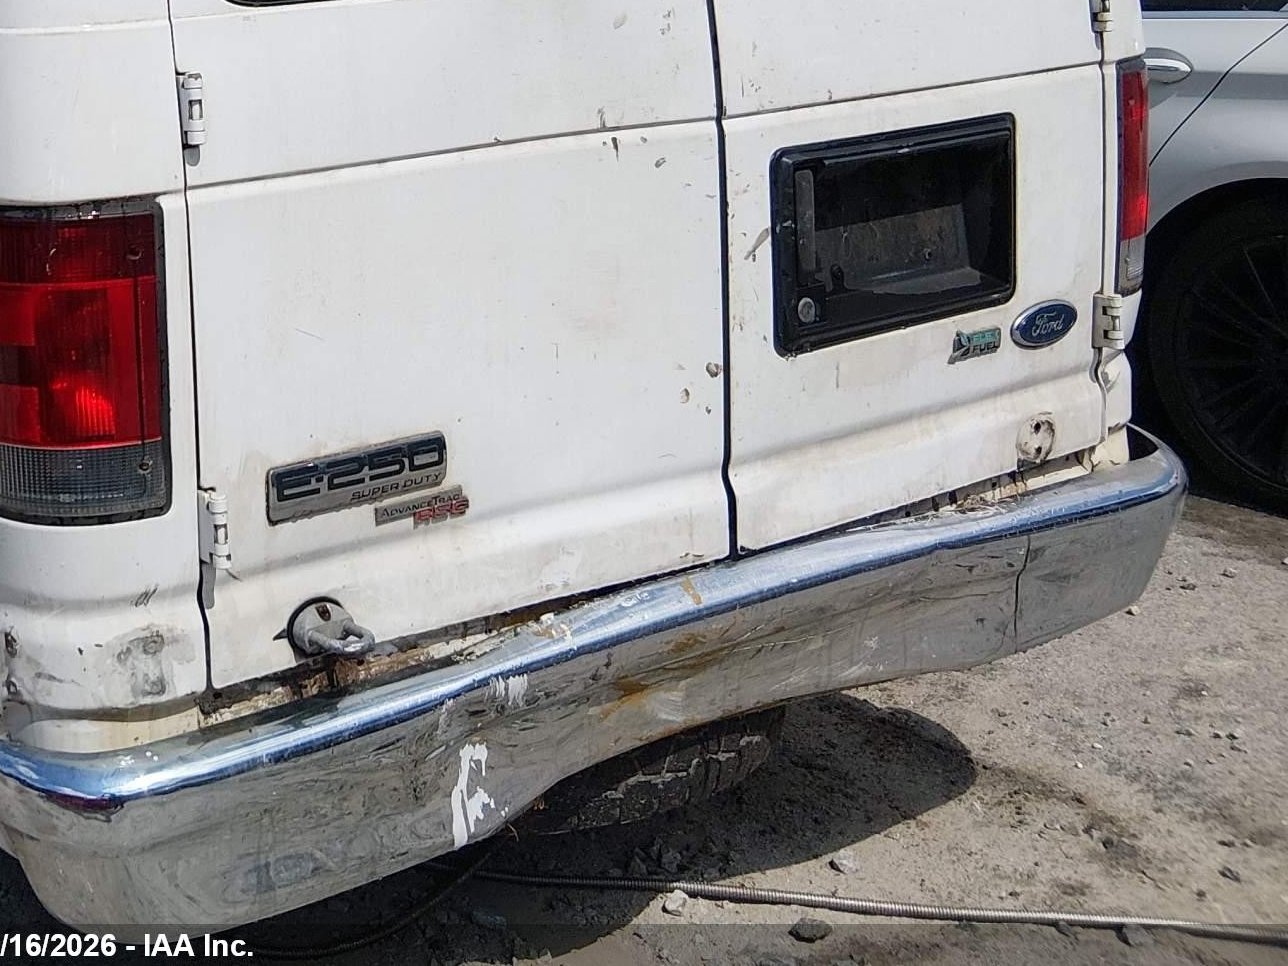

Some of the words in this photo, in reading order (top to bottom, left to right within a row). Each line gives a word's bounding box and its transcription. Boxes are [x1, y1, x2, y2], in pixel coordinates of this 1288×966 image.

[1032, 311, 1065, 336] Ford
[972, 341, 998, 353] FUEL
[350, 479, 401, 500] SUPER
[402, 472, 443, 489] DUTY
